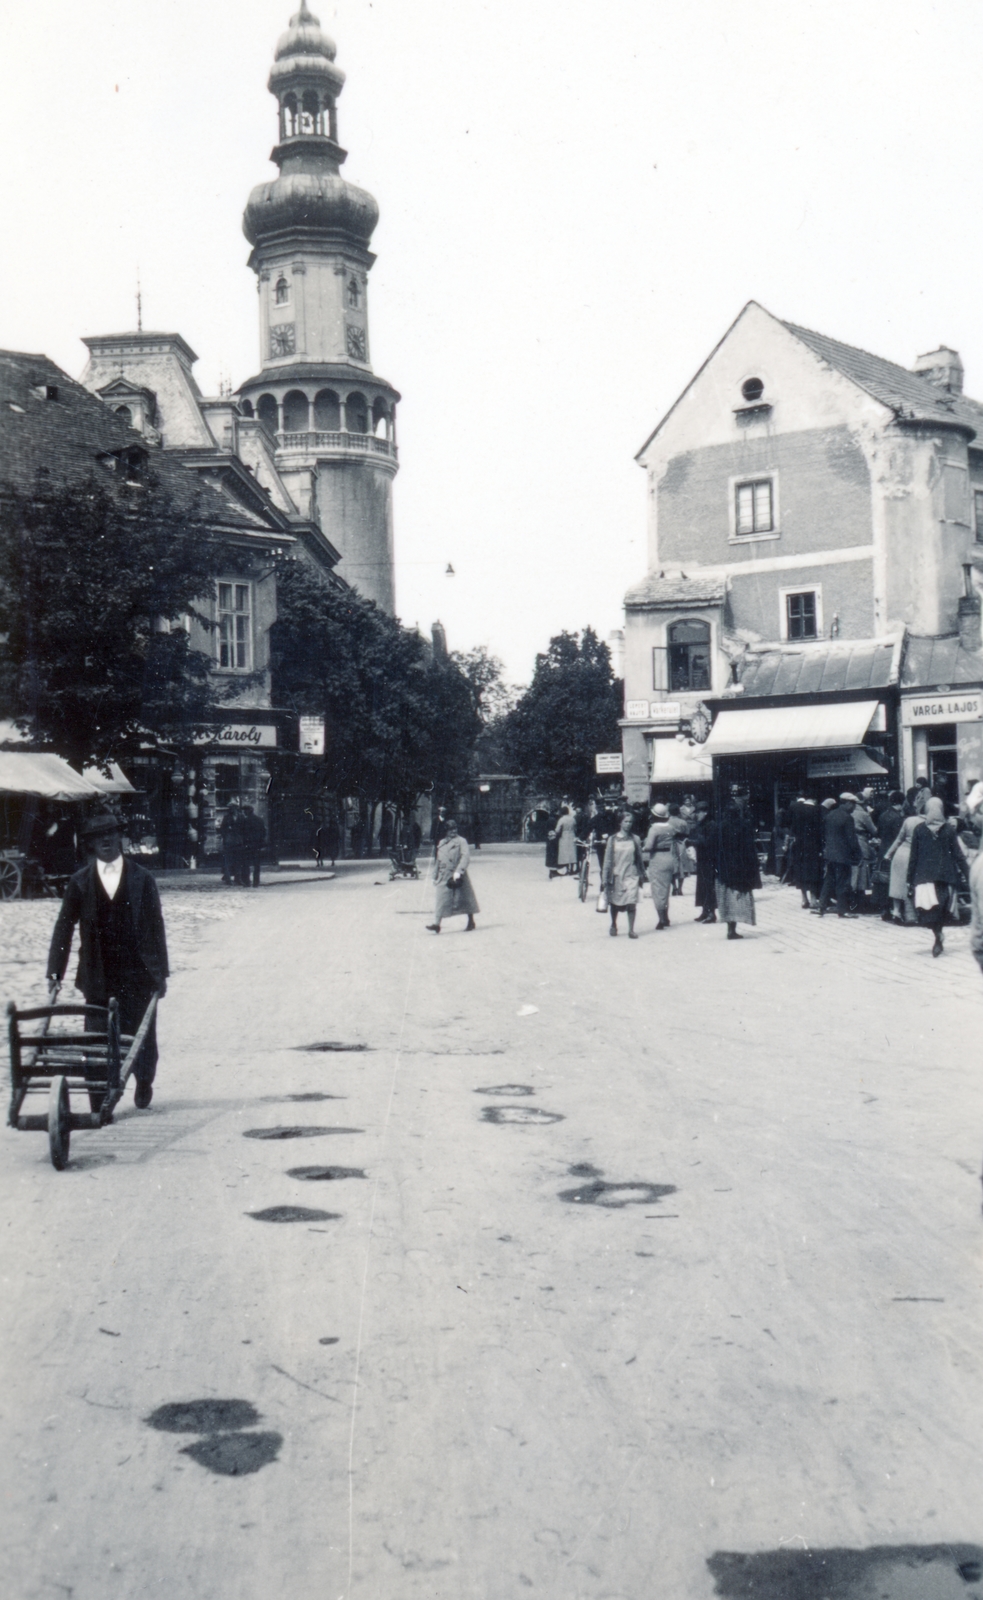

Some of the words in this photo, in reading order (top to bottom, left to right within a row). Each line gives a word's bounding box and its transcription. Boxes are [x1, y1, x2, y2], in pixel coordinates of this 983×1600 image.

[912, 704, 944, 717] VARGA
[948, 701, 978, 714] LAJOS
[213, 725, 262, 744] Károly
